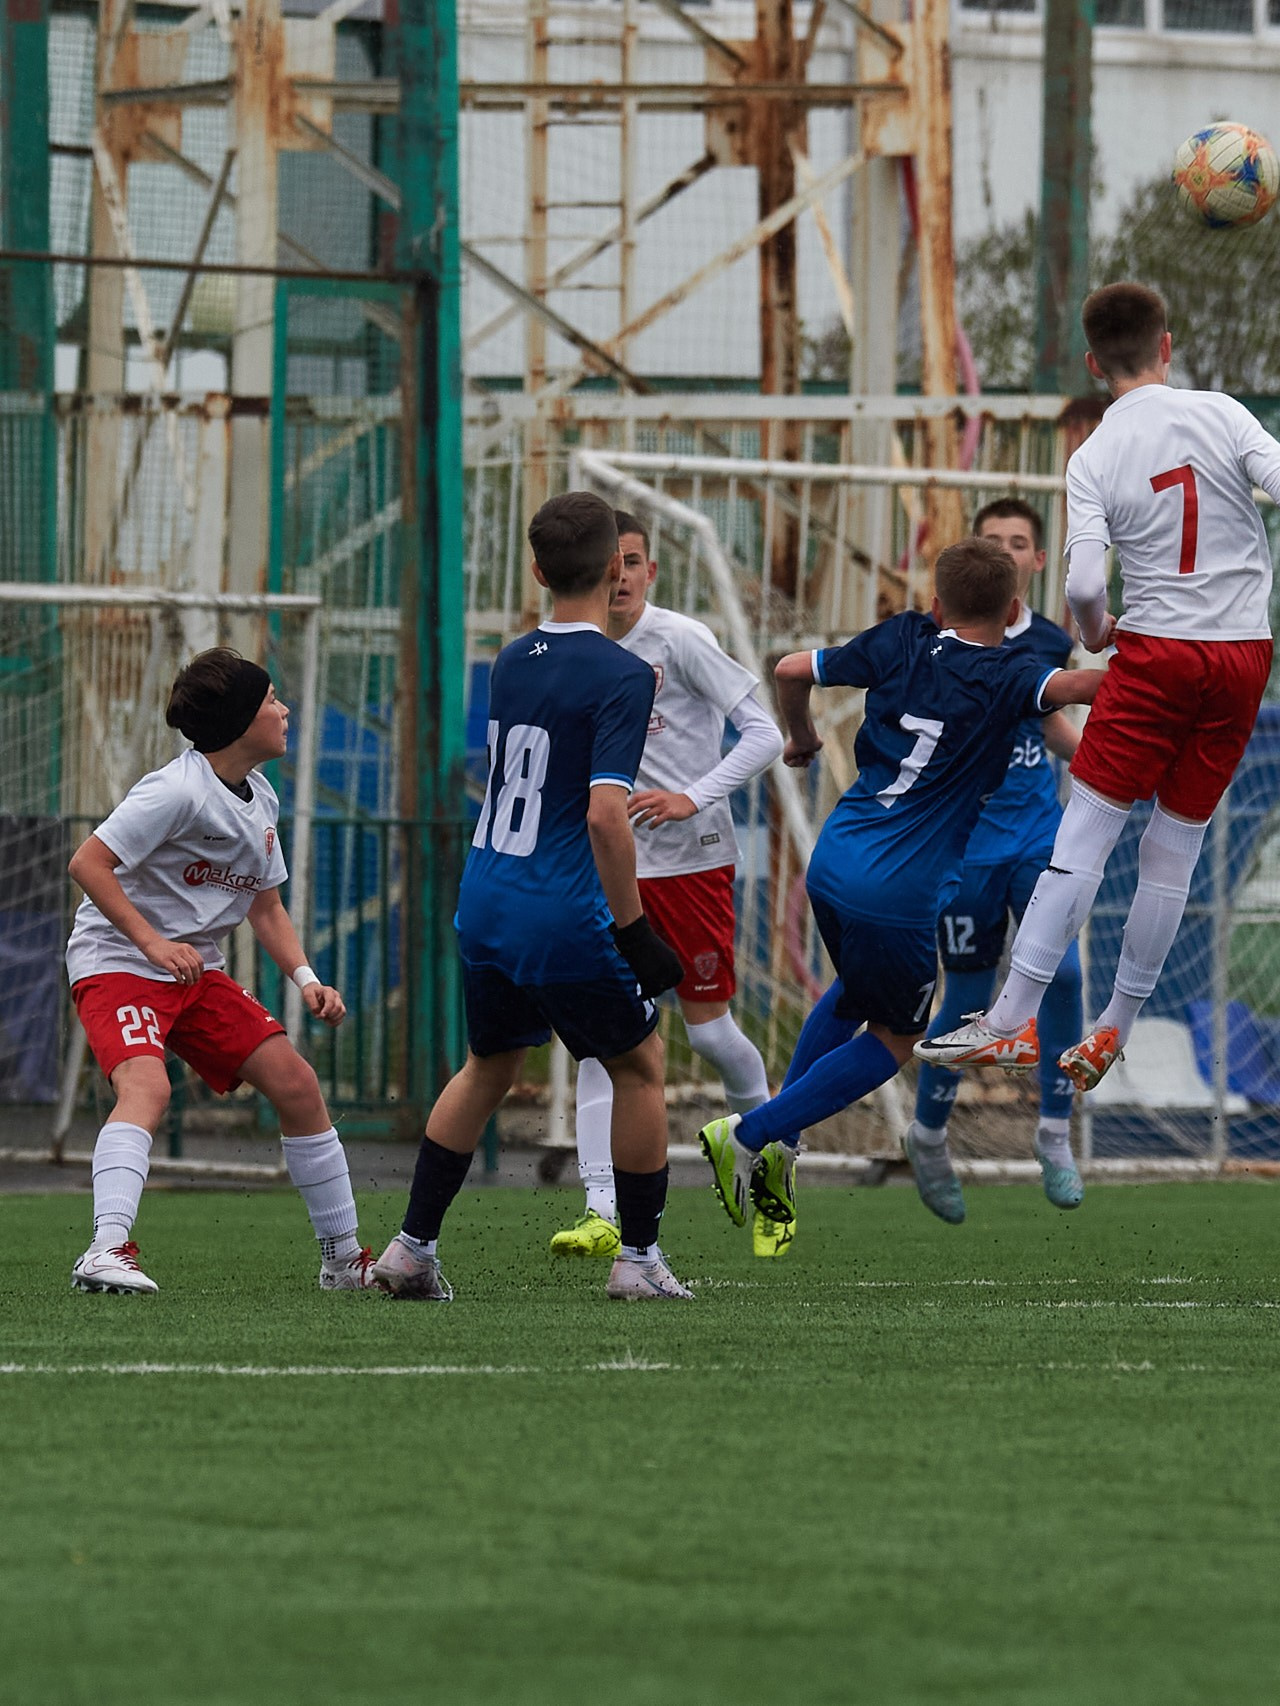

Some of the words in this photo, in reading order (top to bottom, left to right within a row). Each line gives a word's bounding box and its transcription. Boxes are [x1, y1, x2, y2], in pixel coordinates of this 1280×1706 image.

[1149, 464, 1198, 574] 7
[472, 719, 550, 857] 18
[875, 712, 944, 809] 7
[944, 916, 977, 954] 12
[117, 1005, 165, 1050] 22
